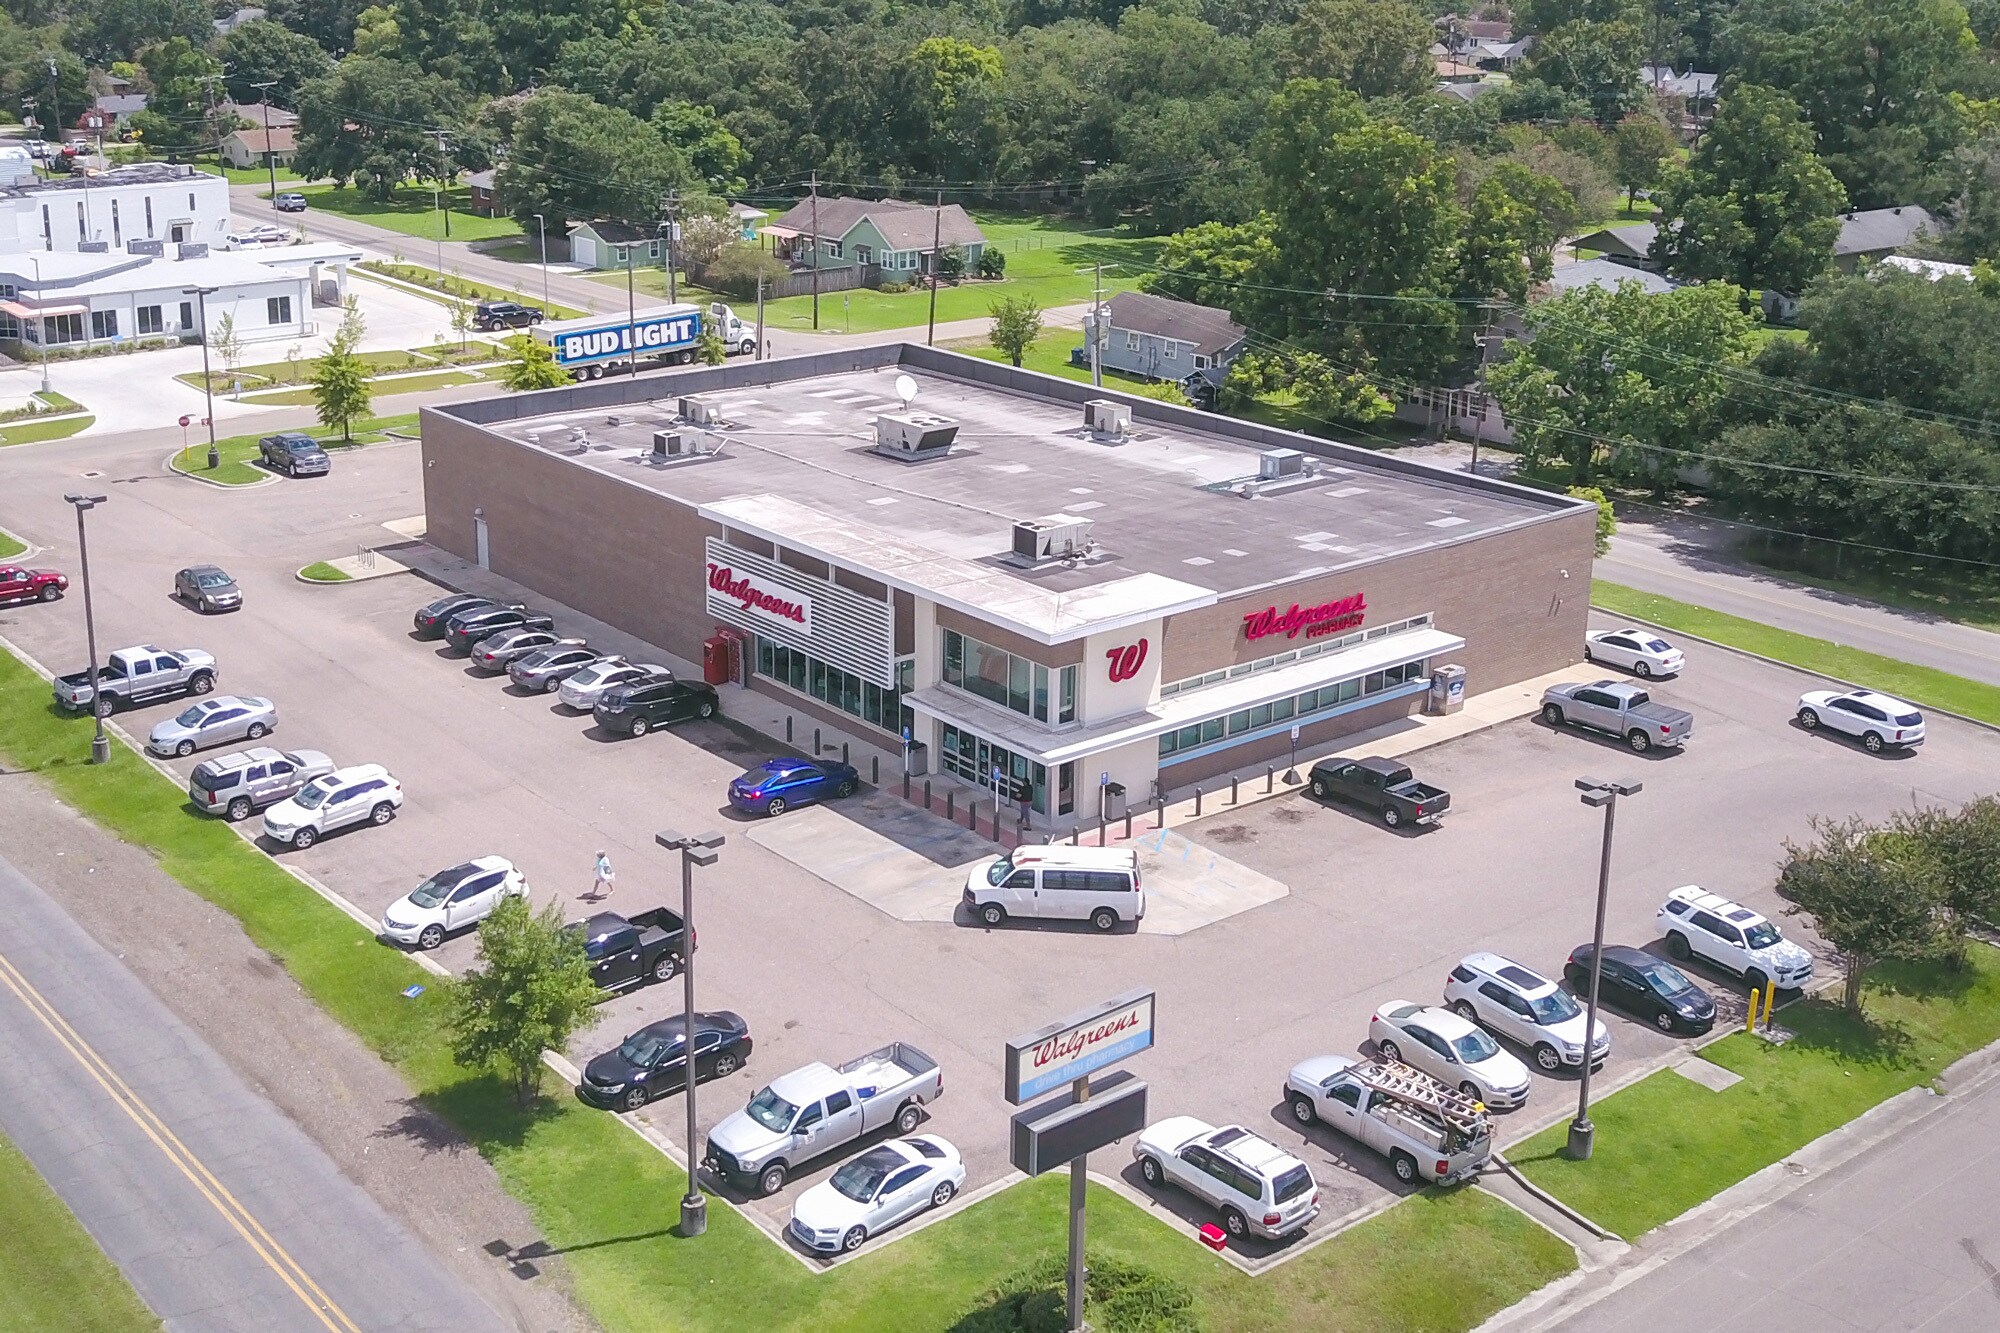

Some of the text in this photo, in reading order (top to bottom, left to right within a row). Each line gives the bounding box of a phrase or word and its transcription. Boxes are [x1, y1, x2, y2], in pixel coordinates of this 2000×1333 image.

[565, 319, 692, 358] BUD LIGHT
[707, 563, 806, 623] Walgreens
[1244, 592, 1367, 640] Walgreens
[1306, 613, 1364, 639] PHARMACY
[1106, 638, 1148, 682] W
[1032, 1010, 1139, 1067] Walgreens
[1035, 1040, 1135, 1090] drive thru pharmacy
